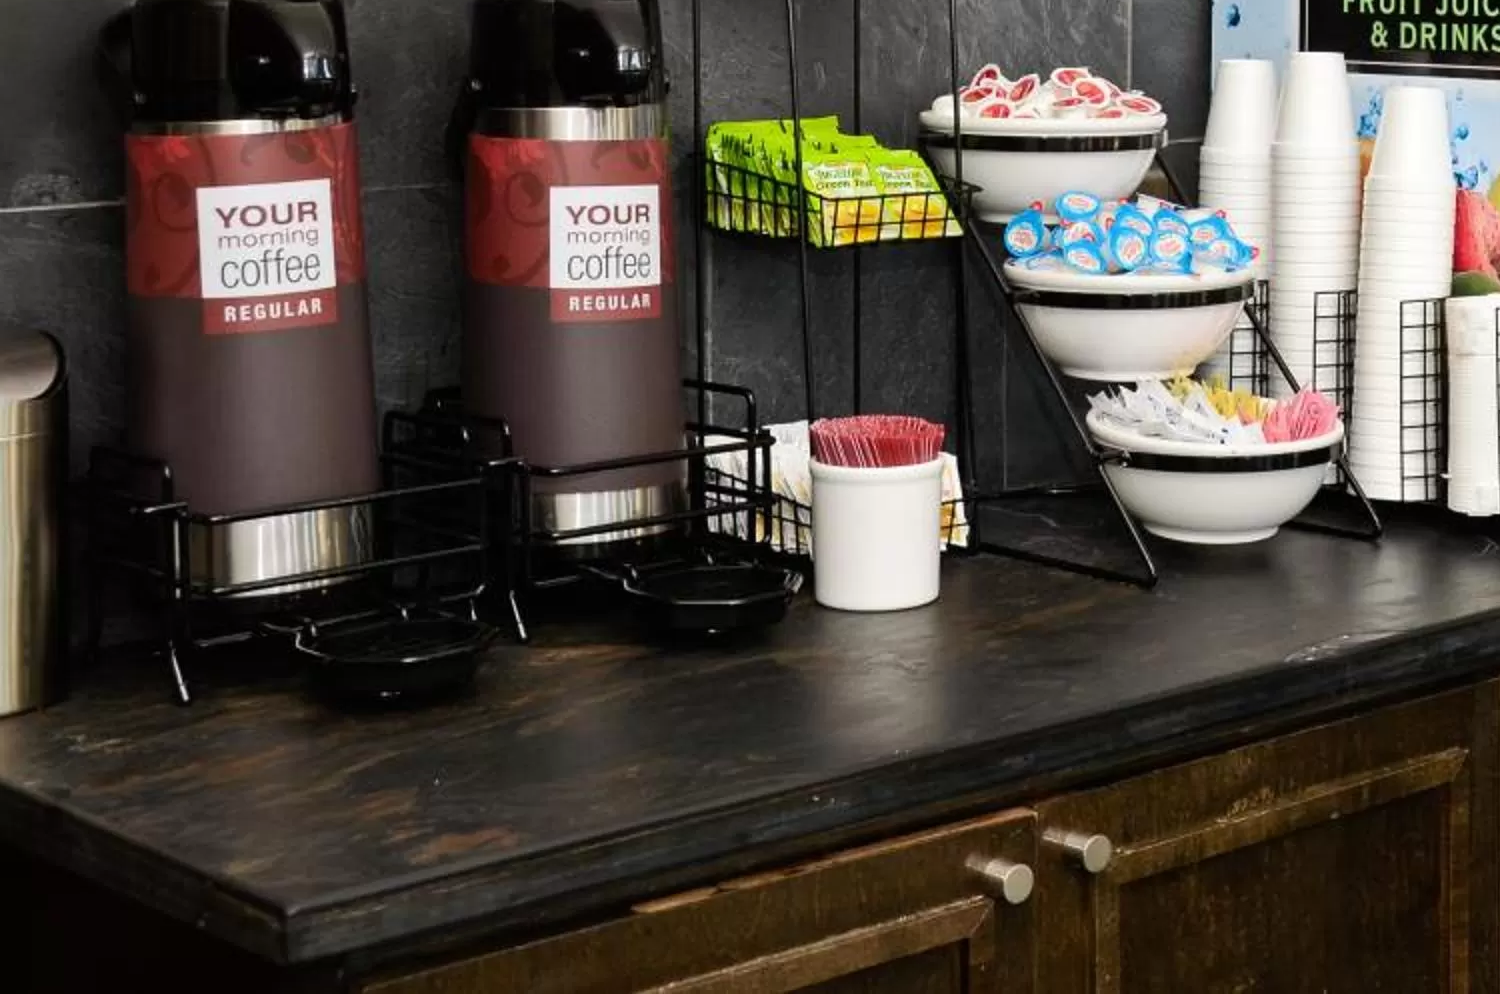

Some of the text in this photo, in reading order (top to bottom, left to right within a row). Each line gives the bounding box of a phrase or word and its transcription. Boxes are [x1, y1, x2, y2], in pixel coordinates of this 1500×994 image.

[1370, 20, 1389, 49] &
[215, 201, 318, 228] YOUR
[565, 204, 650, 225] YOUR
[218, 228, 319, 246] morning
[567, 228, 650, 246] morning
[220, 247, 321, 288] coffee
[567, 246, 651, 281] coffee
[224, 298, 322, 322] REGULAR
[569, 293, 651, 312] REGULAR
